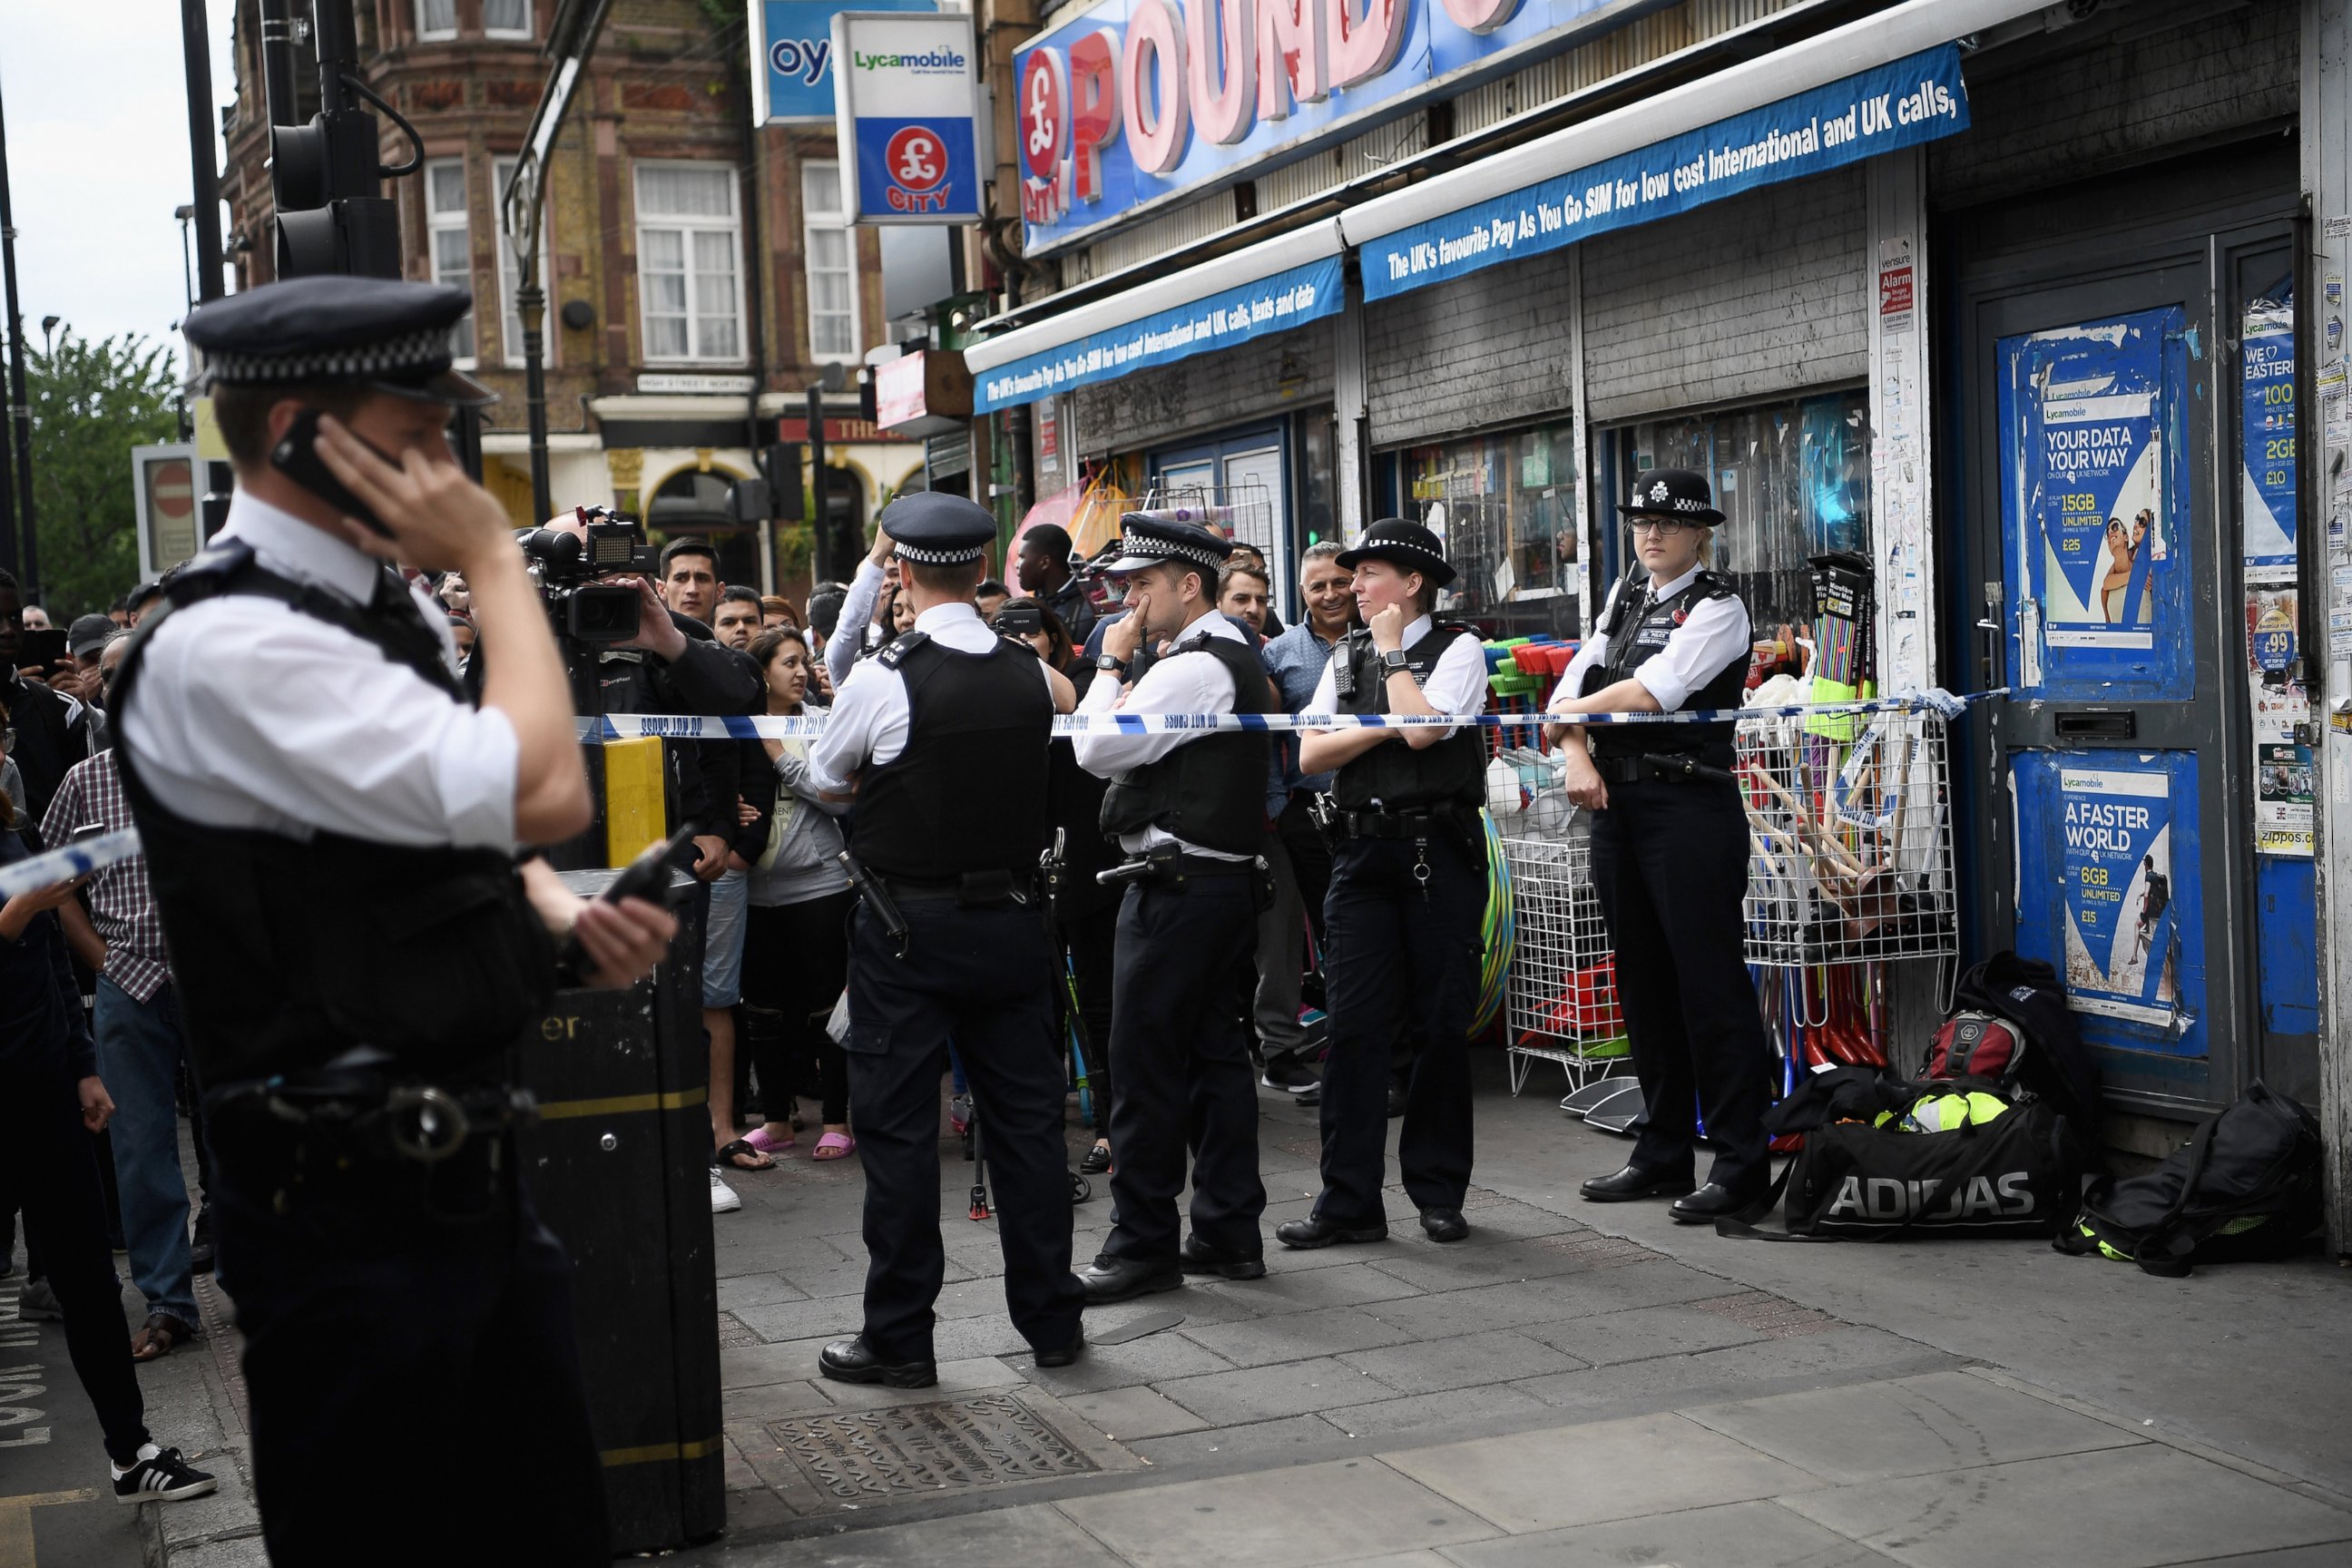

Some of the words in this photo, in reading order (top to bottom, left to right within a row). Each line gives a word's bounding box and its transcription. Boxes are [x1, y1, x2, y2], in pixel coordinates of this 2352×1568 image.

[770, 39, 832, 83] oy
[854, 51, 965, 71] Lycamobile
[1387, 253, 1408, 280] The
[1410, 242, 1437, 274] UK's
[1439, 226, 1490, 265] favourite
[1491, 218, 1515, 249] Pay
[1518, 210, 1536, 240] As
[1537, 204, 1562, 233] You
[1563, 194, 1583, 225] Go
[1585, 181, 1612, 219] SIM
[1615, 179, 1638, 210] for
[1642, 171, 1670, 202] low
[1673, 154, 1706, 192] cost
[1708, 117, 1820, 181] International
[1823, 104, 1857, 148] and
[1861, 93, 1893, 136] UK
[1897, 79, 1956, 125] calls,
[886, 182, 952, 212] CITY
[1882, 273, 1912, 289] Alarm
[987, 381, 999, 402] The
[1144, 318, 1194, 355] International
[1194, 313, 1211, 340] and
[1212, 309, 1229, 336] UK
[1229, 303, 1251, 331] calls,
[1251, 296, 1275, 322] texts
[1276, 288, 1295, 316] and
[1296, 283, 1316, 310] data
[2246, 348, 2264, 364] WE
[2046, 407, 2086, 420] Lycamobile
[2264, 406, 2286, 414] MINUTES
[2047, 429, 2089, 451] YOUR
[2091, 426, 2132, 448] DATA
[2047, 449, 2090, 471] YOUR
[2091, 446, 2128, 468] WAY
[2047, 472, 2055, 480] ON
[2082, 469, 2110, 478] NETWORK
[2266, 470, 2286, 485] £10
[2062, 494, 2095, 512] 15GB
[2062, 515, 2102, 526] UNLIMITED
[2063, 538, 2081, 552] £25
[1828, 588, 1840, 597] Floor
[1841, 592, 1853, 602] Mop
[1829, 582, 1853, 595] Microfibre
[1853, 632, 1861, 669] Microfibre
[2265, 632, 2288, 653] £99
[640, 717, 669, 736] CROSS
[671, 717, 689, 736] NOT
[690, 717, 702, 737] DO
[784, 716, 803, 735] LINE
[1053, 714, 1062, 730] LI
[1063, 714, 1089, 730] POLICE
[1164, 713, 1189, 730] CROSS
[1191, 714, 1206, 730] NOT
[1208, 714, 1218, 729] DO
[1289, 714, 1305, 726] LINE
[1308, 714, 1331, 726] POLICE
[2064, 777, 2103, 789] Lycamobile
[2064, 802, 2078, 824] A
[2081, 802, 2150, 830] FASTER
[2064, 825, 2131, 852] WORLD
[2066, 848, 2079, 856] WITH
[2079, 848, 2091, 857] OUR
[2107, 851, 2132, 860] NETWORK
[2081, 866, 2109, 886] 6GB
[2081, 887, 2121, 902] UNLIMITED
[2082, 910, 2097, 924] £15
[541, 1015, 580, 1041] er
[1828, 1171, 2035, 1219] ADIDAS
